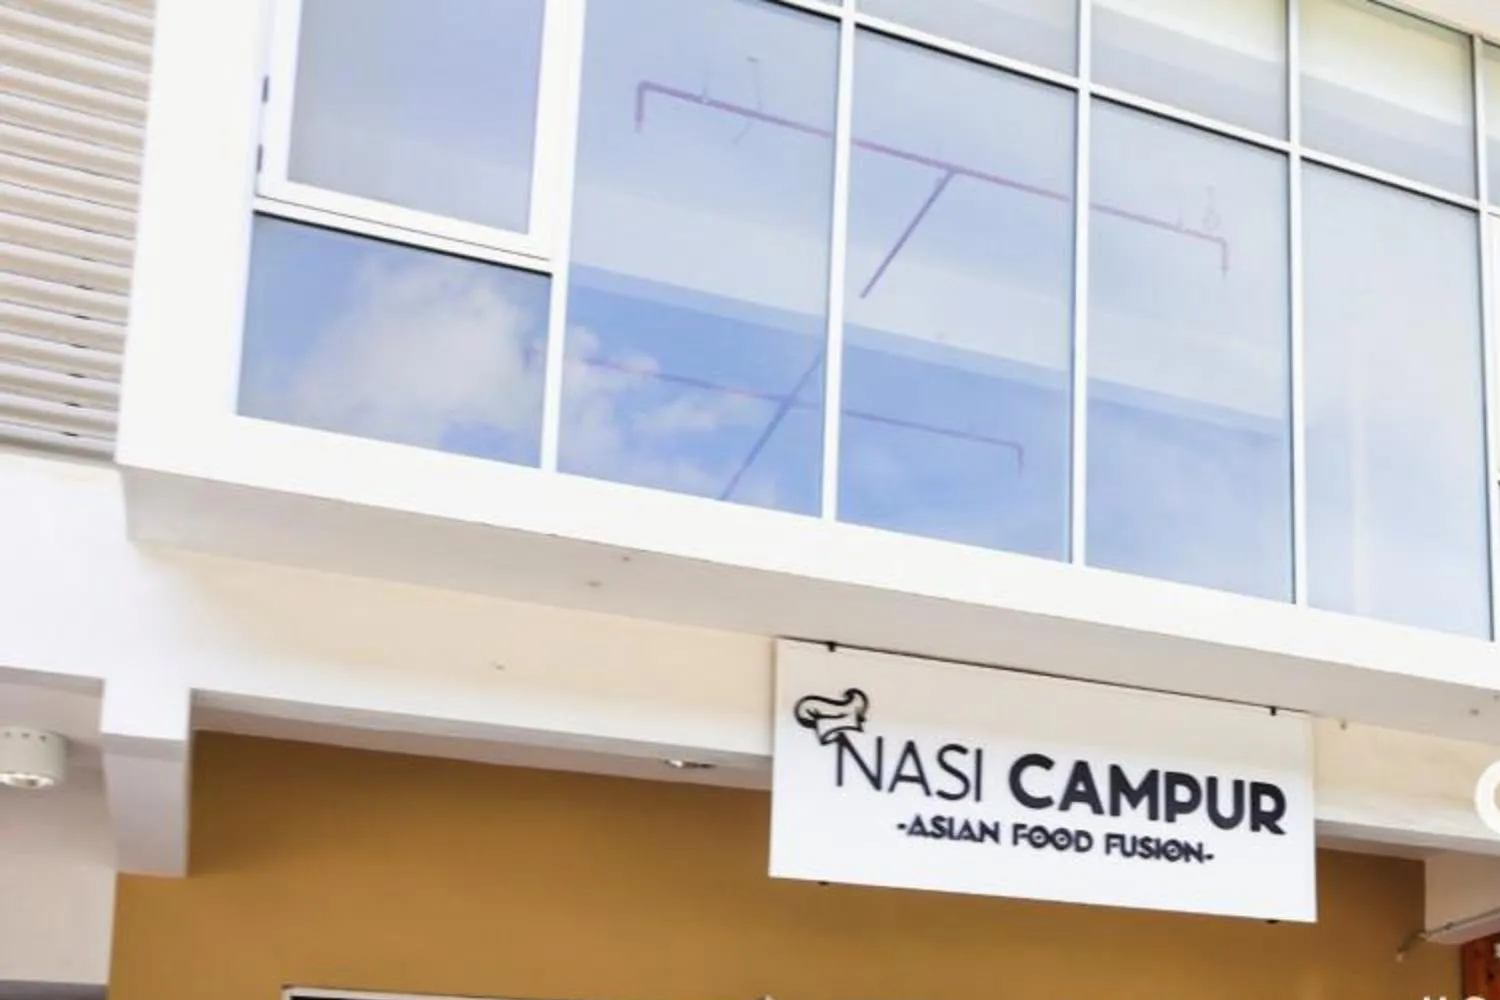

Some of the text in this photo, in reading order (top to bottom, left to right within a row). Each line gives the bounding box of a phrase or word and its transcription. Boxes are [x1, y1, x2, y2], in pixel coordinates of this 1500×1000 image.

[836, 733, 1287, 836] NASI CAMPUR
[1012, 825, 1093, 853] FOOD
